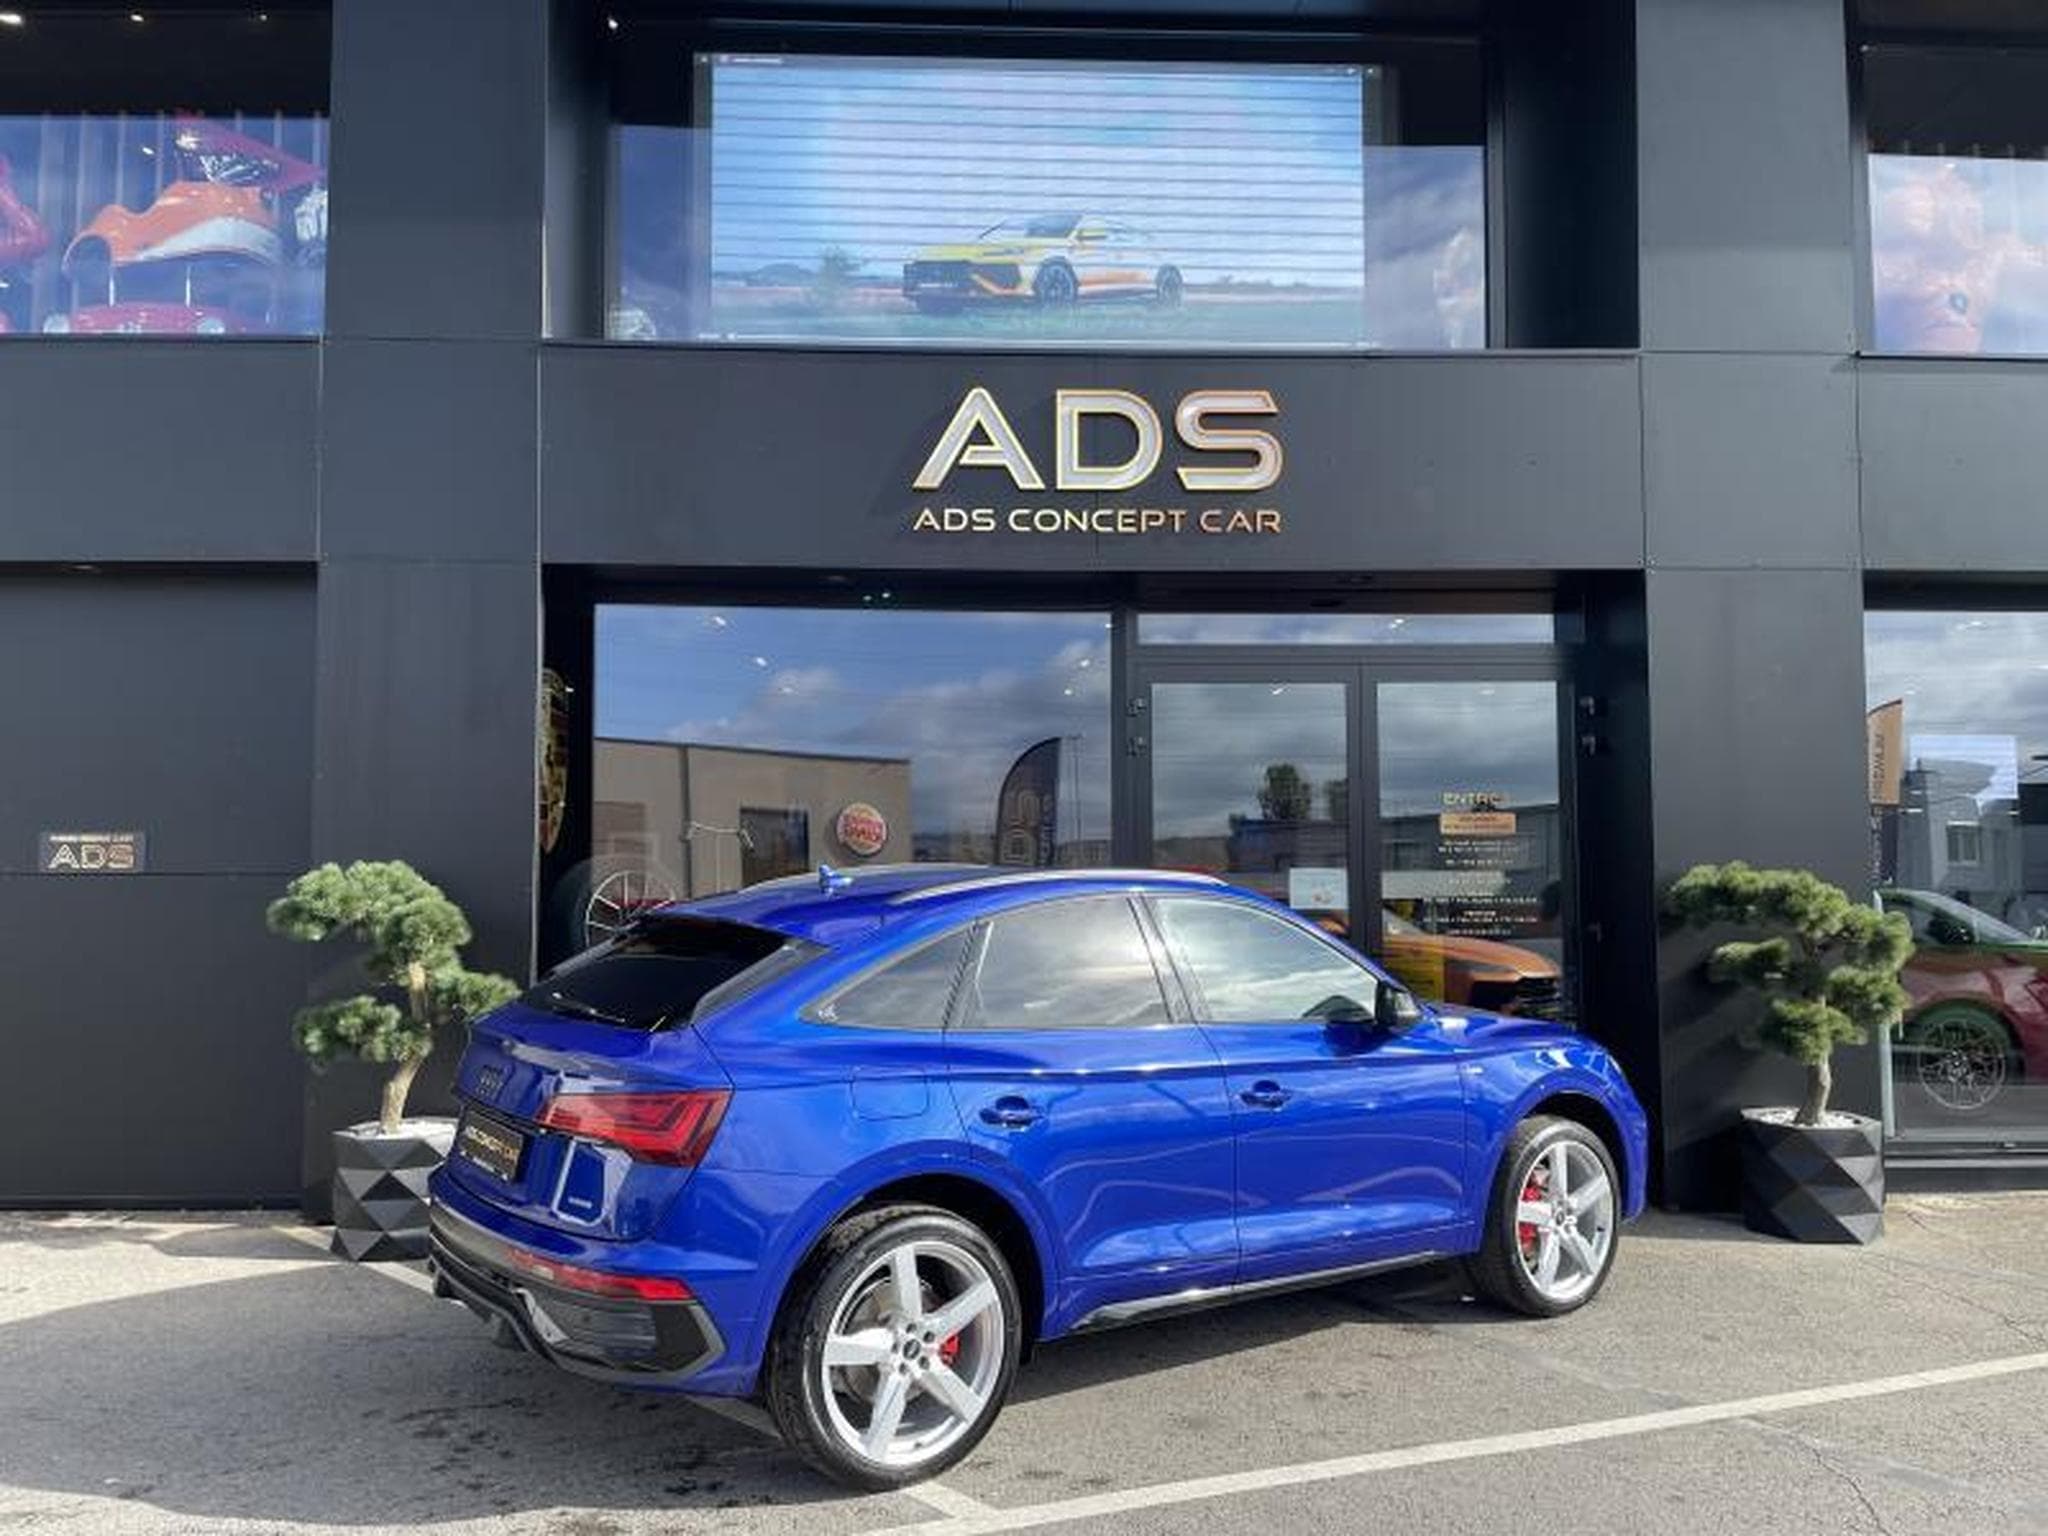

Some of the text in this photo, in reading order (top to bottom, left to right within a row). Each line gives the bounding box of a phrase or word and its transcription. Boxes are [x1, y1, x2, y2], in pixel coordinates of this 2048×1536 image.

[911, 386, 1284, 491] ADS
[912, 507, 1282, 534] ADS CONCEPT CAR
[47, 842, 135, 870] ADS
